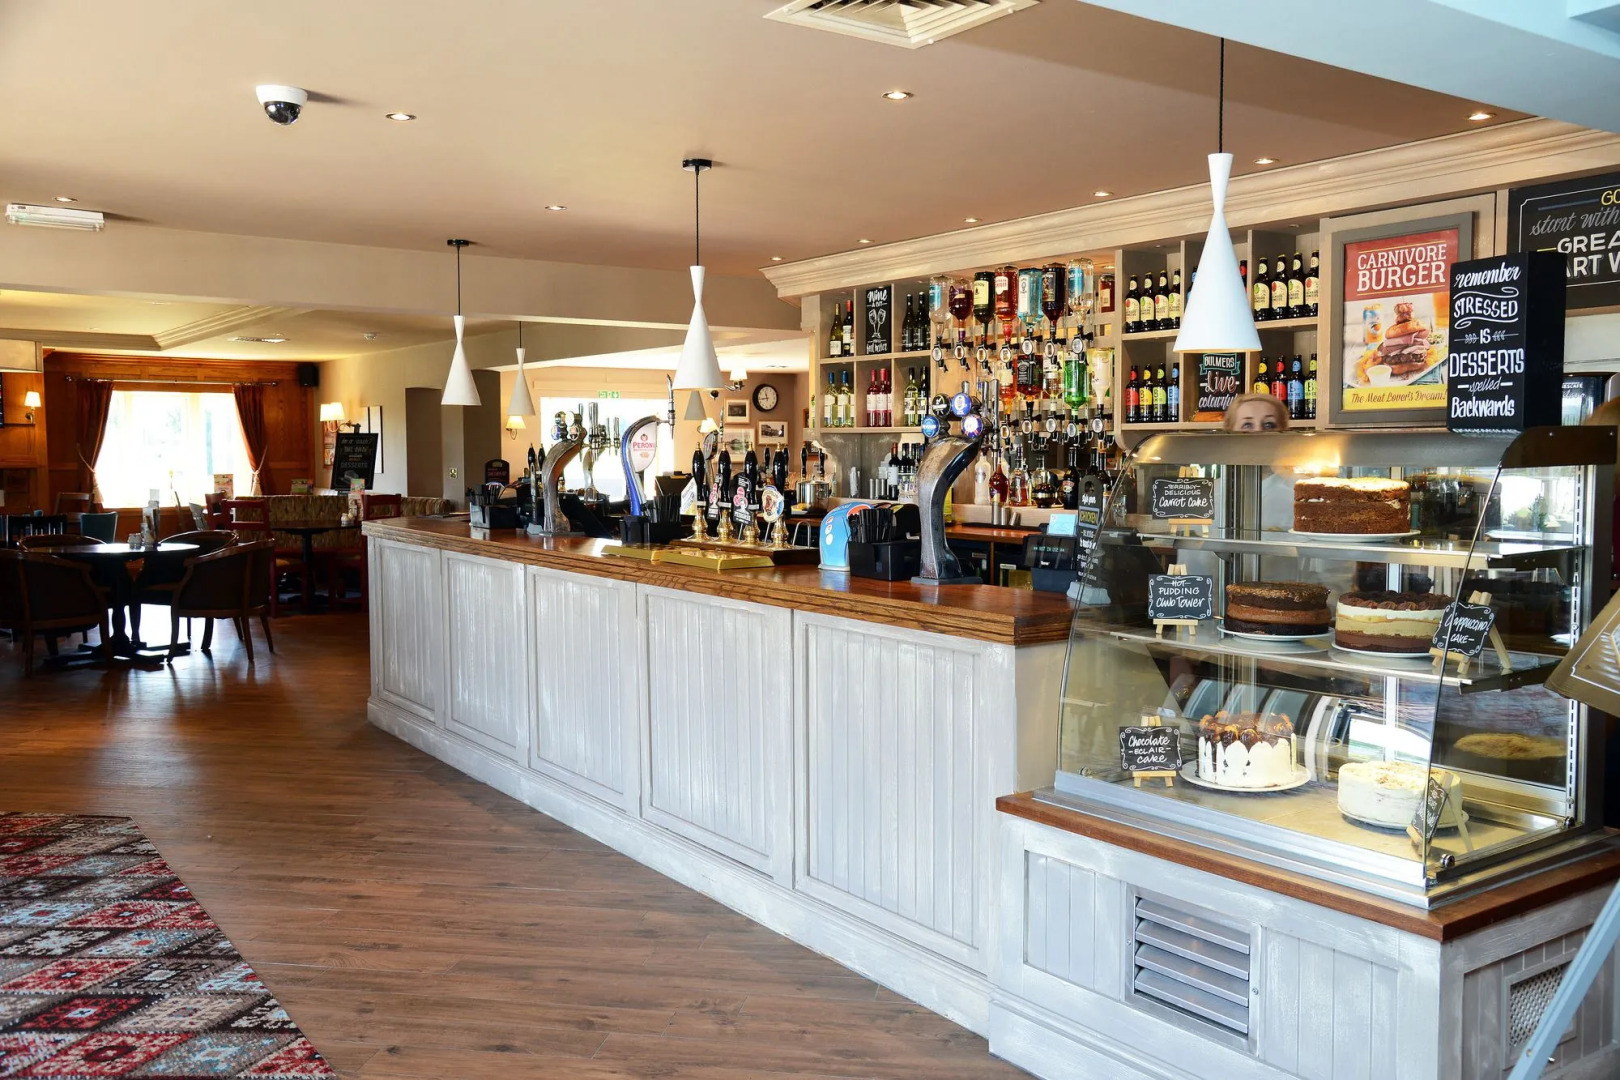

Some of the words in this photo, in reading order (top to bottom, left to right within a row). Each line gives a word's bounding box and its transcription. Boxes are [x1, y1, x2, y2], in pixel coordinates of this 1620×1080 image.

[1529, 212, 1577, 236] start
[1580, 206, 1620, 229] with
[1357, 243, 1447, 270] CARNIVORE
[1356, 261, 1446, 292] BURGER
[1453, 262, 1522, 289] remember
[1453, 297, 1519, 319] STRESSED
[1479, 328, 1491, 344] IS
[1204, 356, 1235, 369] BULMERS
[1449, 348, 1525, 378] DESSERTS
[1204, 370, 1236, 393] Live
[1468, 377, 1502, 397] spelled
[1351, 393, 1364, 404] The
[1365, 391, 1385, 403] Meat
[1386, 391, 1414, 402] Lover's
[1414, 388, 1448, 401] Dream!
[1451, 394, 1515, 419] Backwards
[1158, 496, 1187, 508] Carrot
[1187, 496, 1209, 508] Cake
[1158, 587, 1200, 596] PUDDING
[1155, 597, 1176, 608] Club
[1175, 595, 1206, 608] Tower
[1450, 633, 1469, 644] CAKE
[1128, 735, 1171, 748] Chocolate
[1134, 747, 1166, 755] ECLAIR
